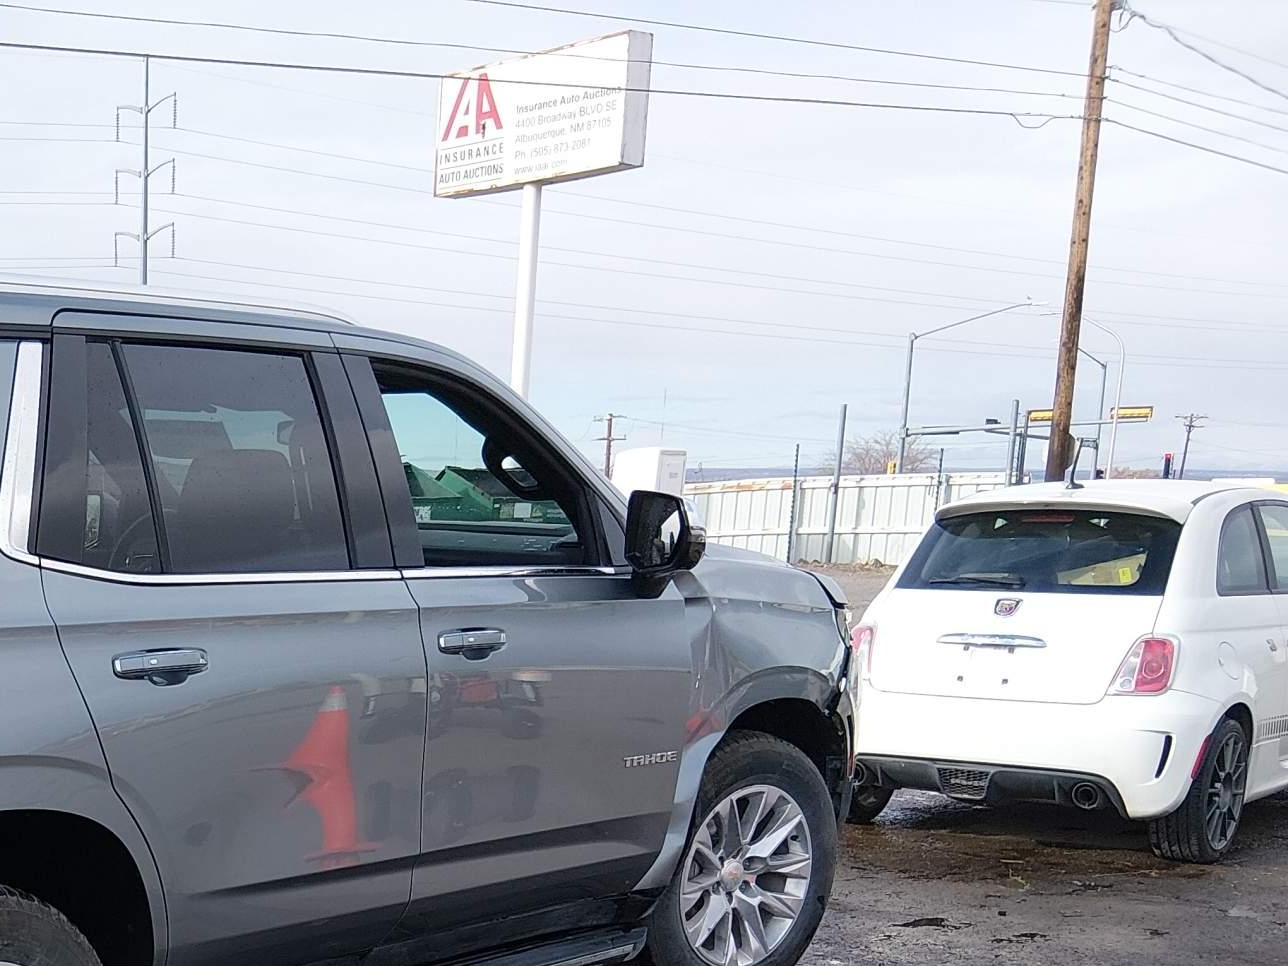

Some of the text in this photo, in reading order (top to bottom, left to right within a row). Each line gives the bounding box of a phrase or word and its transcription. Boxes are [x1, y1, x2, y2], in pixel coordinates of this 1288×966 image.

[516, 86, 622, 113] Insurance Auto Auctions
[537, 110, 577, 126] Broadway
[606, 99, 617, 112] SE
[570, 122, 585, 133] NM
[439, 142, 504, 166] INSURANCE
[439, 162, 504, 184] AUTO AUCTIONS
[623, 751, 678, 768] TAHOE
